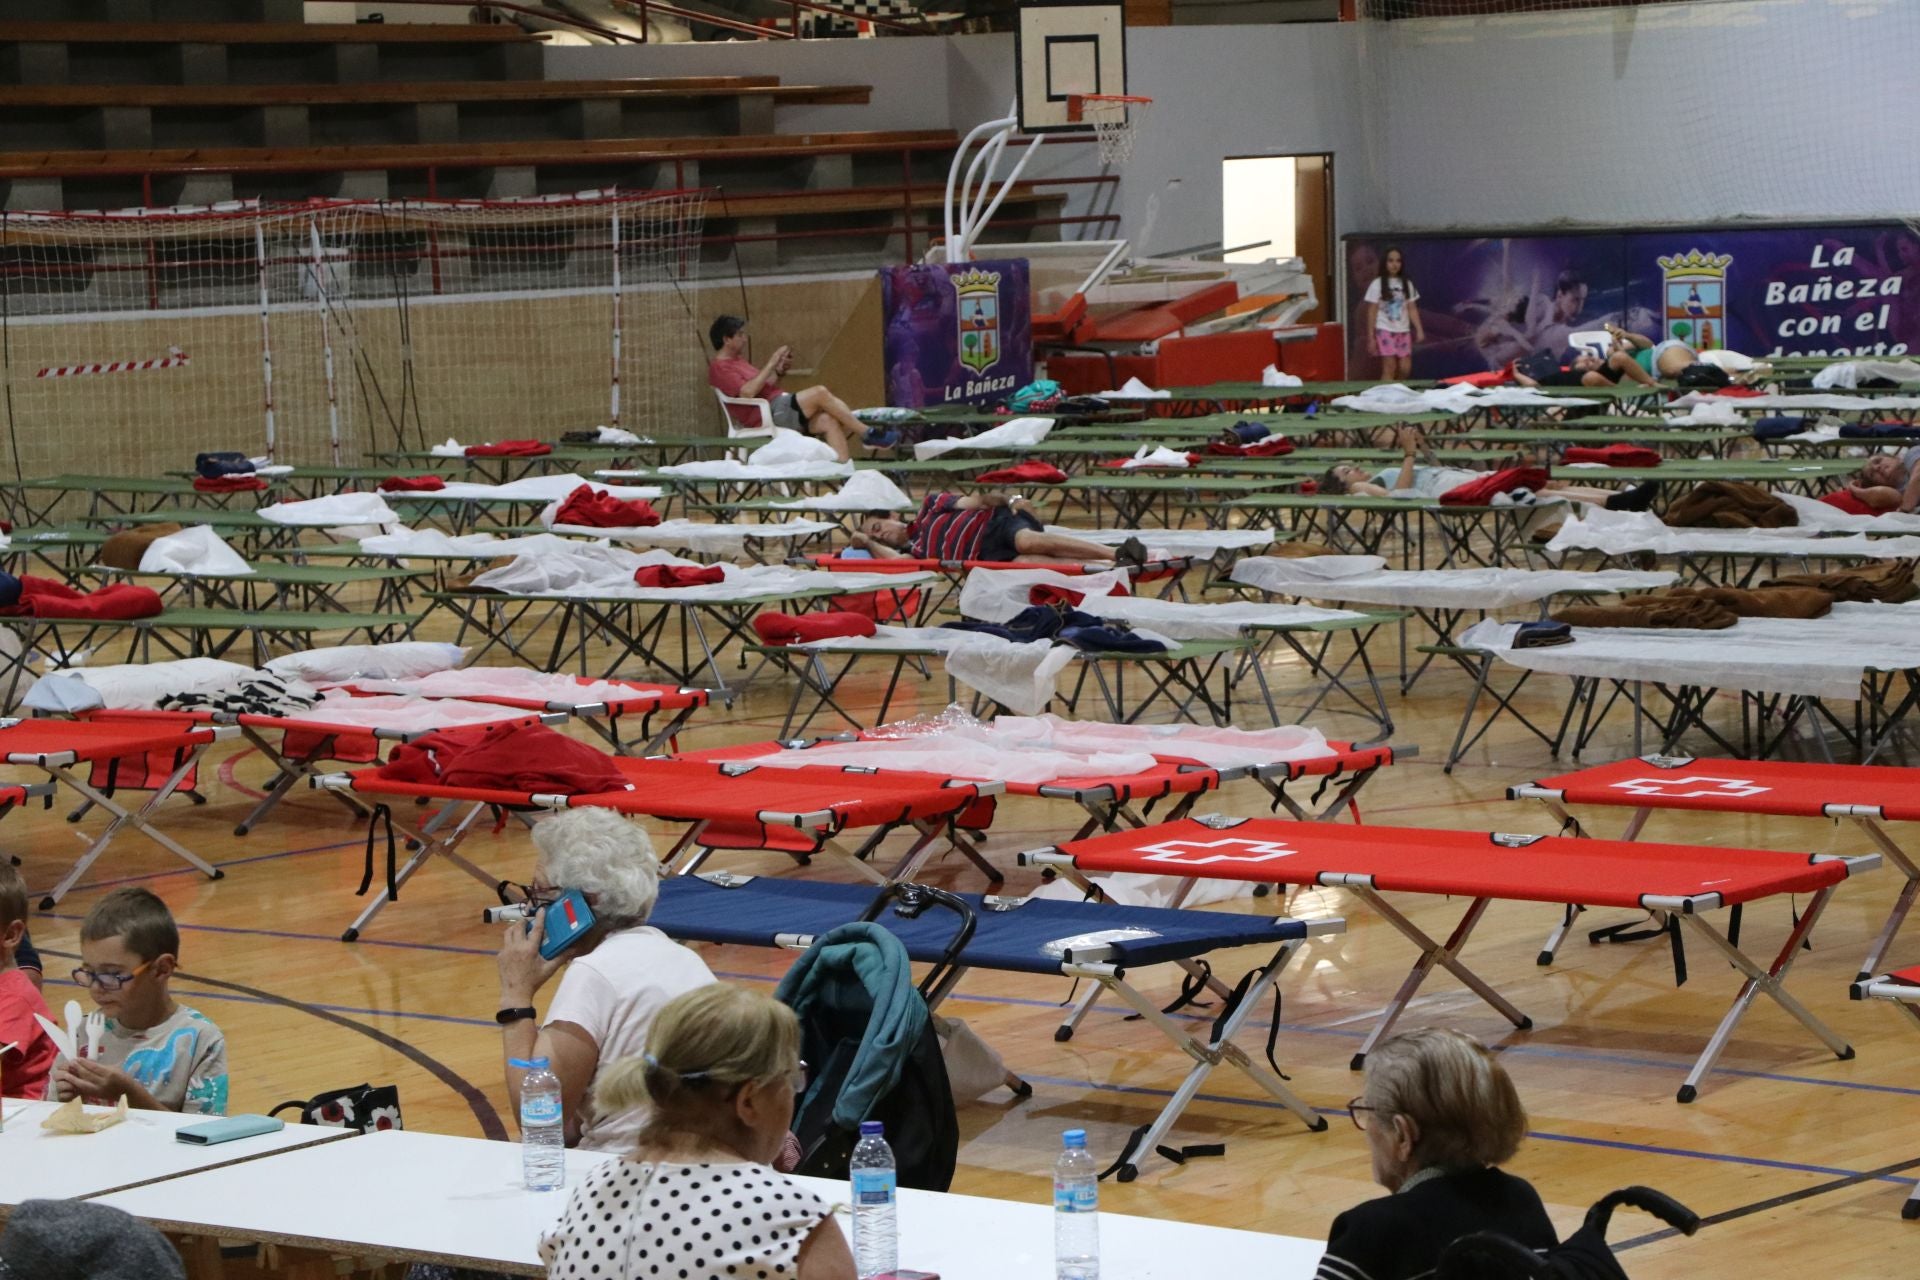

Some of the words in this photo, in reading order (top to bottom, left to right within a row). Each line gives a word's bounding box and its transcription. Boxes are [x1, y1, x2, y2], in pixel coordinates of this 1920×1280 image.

[1810, 244, 1855, 268] La
[1764, 275, 1903, 306] Bañeza
[1777, 314, 1842, 338] con
[1854, 303, 1890, 331] el
[944, 385, 961, 401] La
[966, 375, 1015, 396] Bañeza
